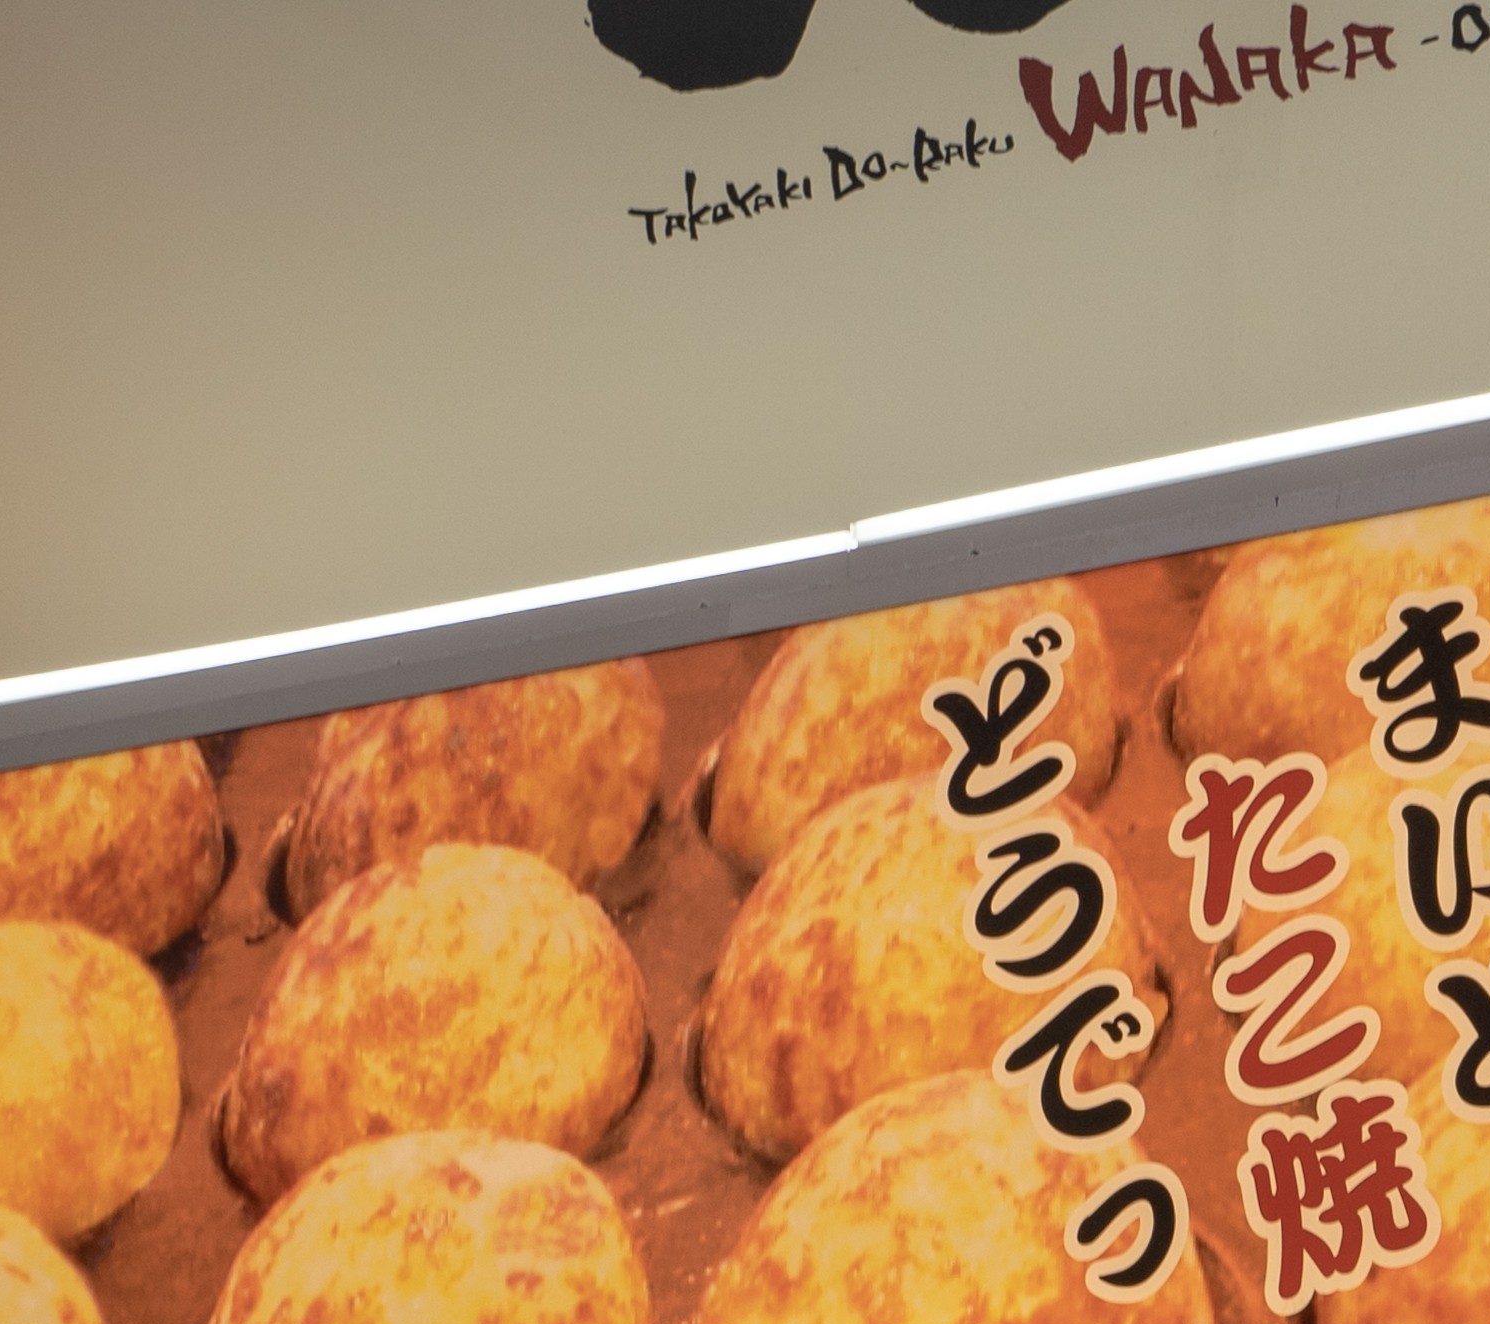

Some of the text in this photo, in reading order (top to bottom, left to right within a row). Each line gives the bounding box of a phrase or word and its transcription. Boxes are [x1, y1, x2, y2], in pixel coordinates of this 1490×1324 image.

[1019, 4, 1397, 163] WANAKA
[1182, 766, 1428, 1298] たこ焼
